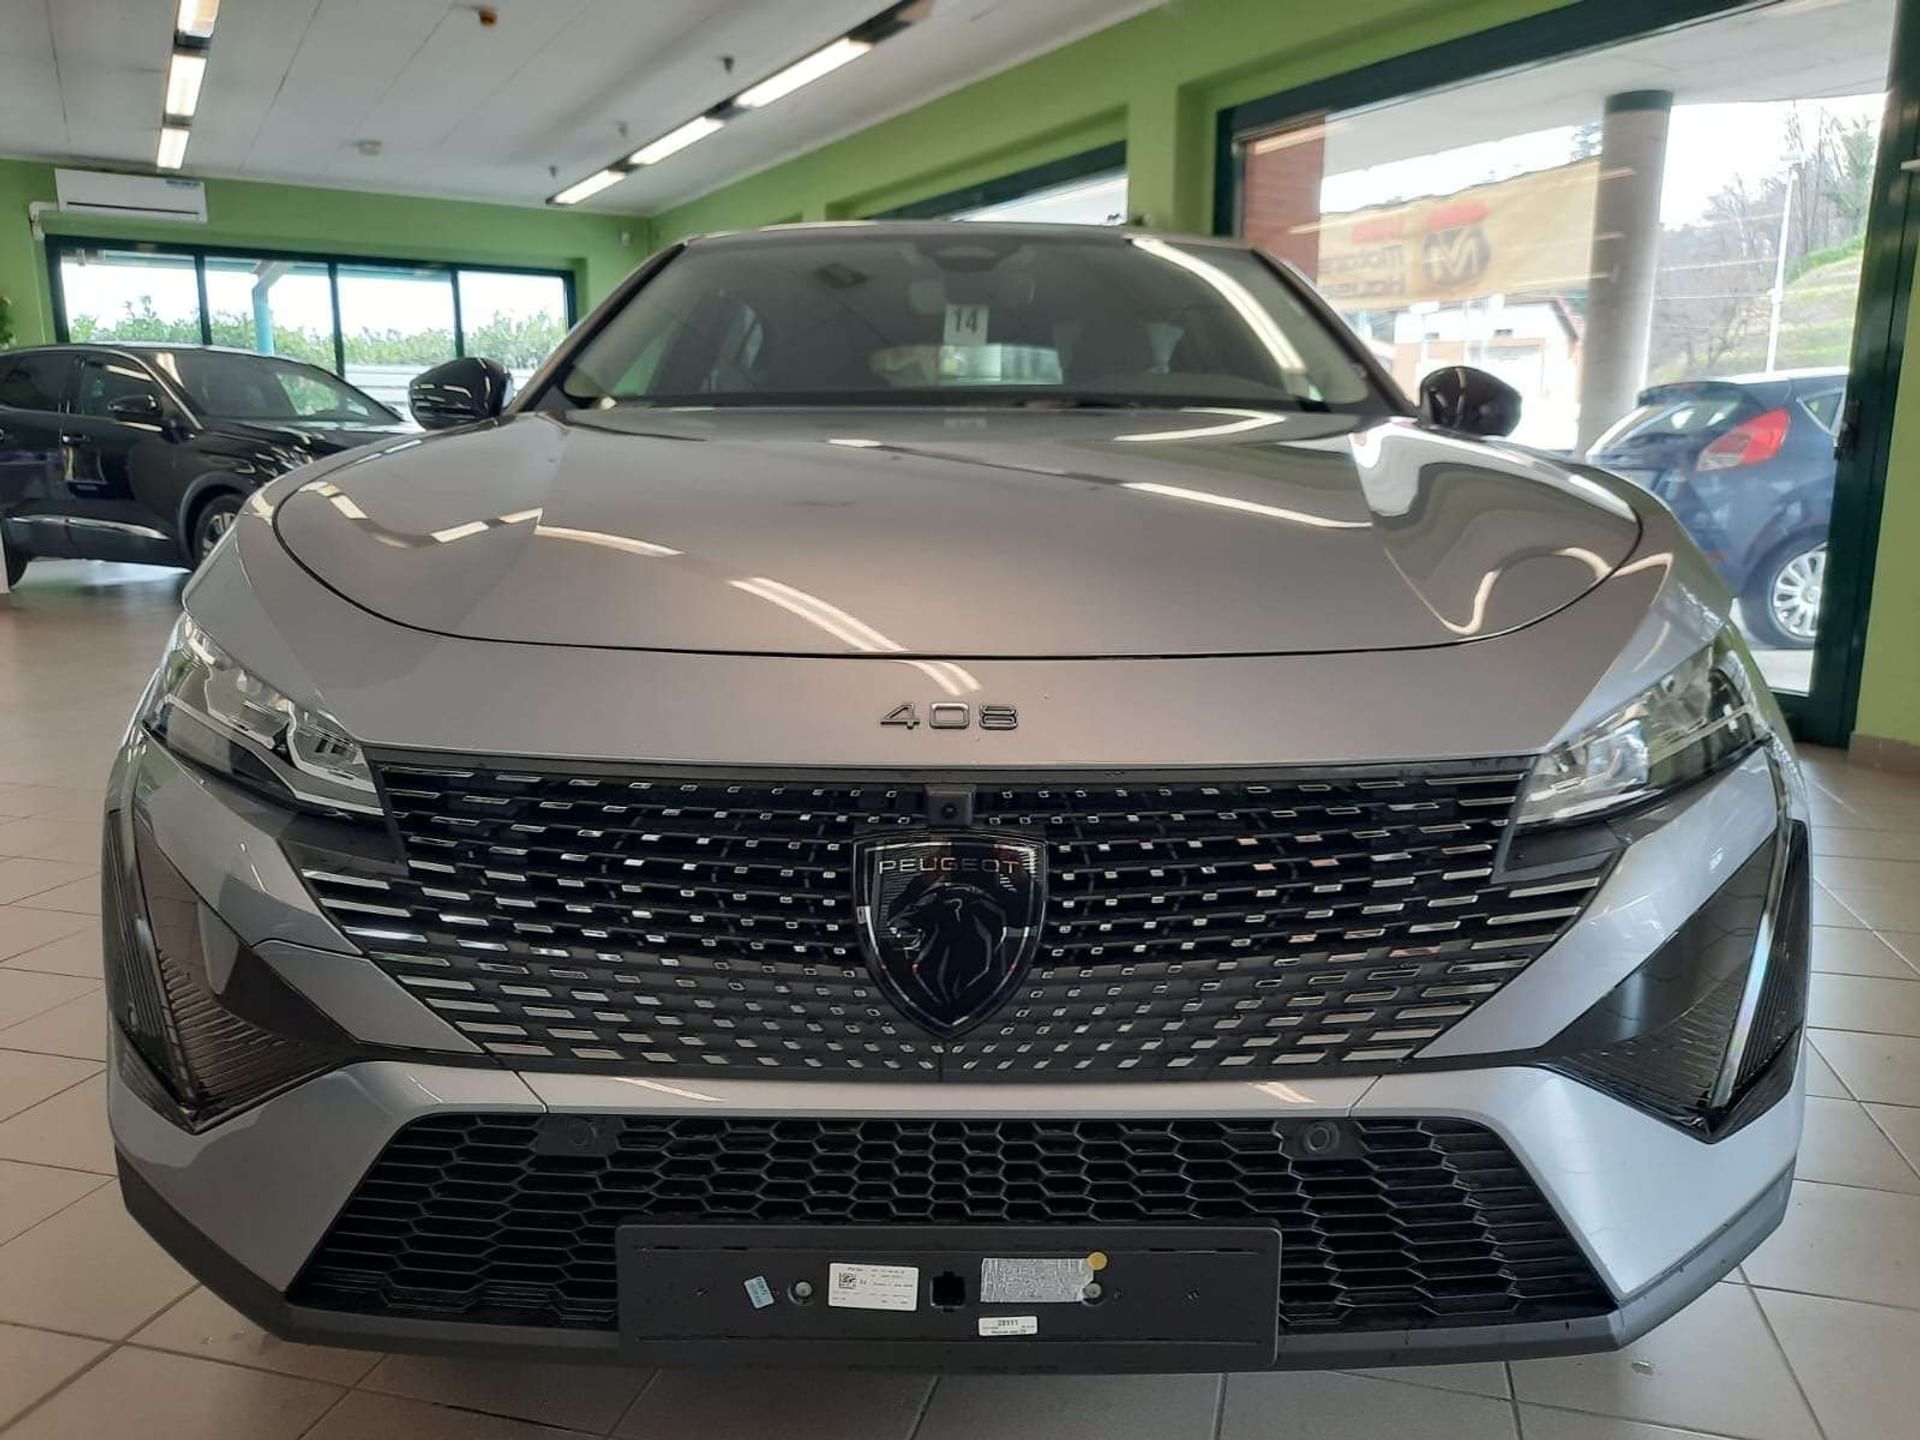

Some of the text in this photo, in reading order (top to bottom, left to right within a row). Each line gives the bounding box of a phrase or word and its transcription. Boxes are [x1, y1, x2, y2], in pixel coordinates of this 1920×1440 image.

[951, 308, 977, 334] 14
[880, 702, 1019, 730] 408
[879, 857, 1019, 874] PEUGEOT
